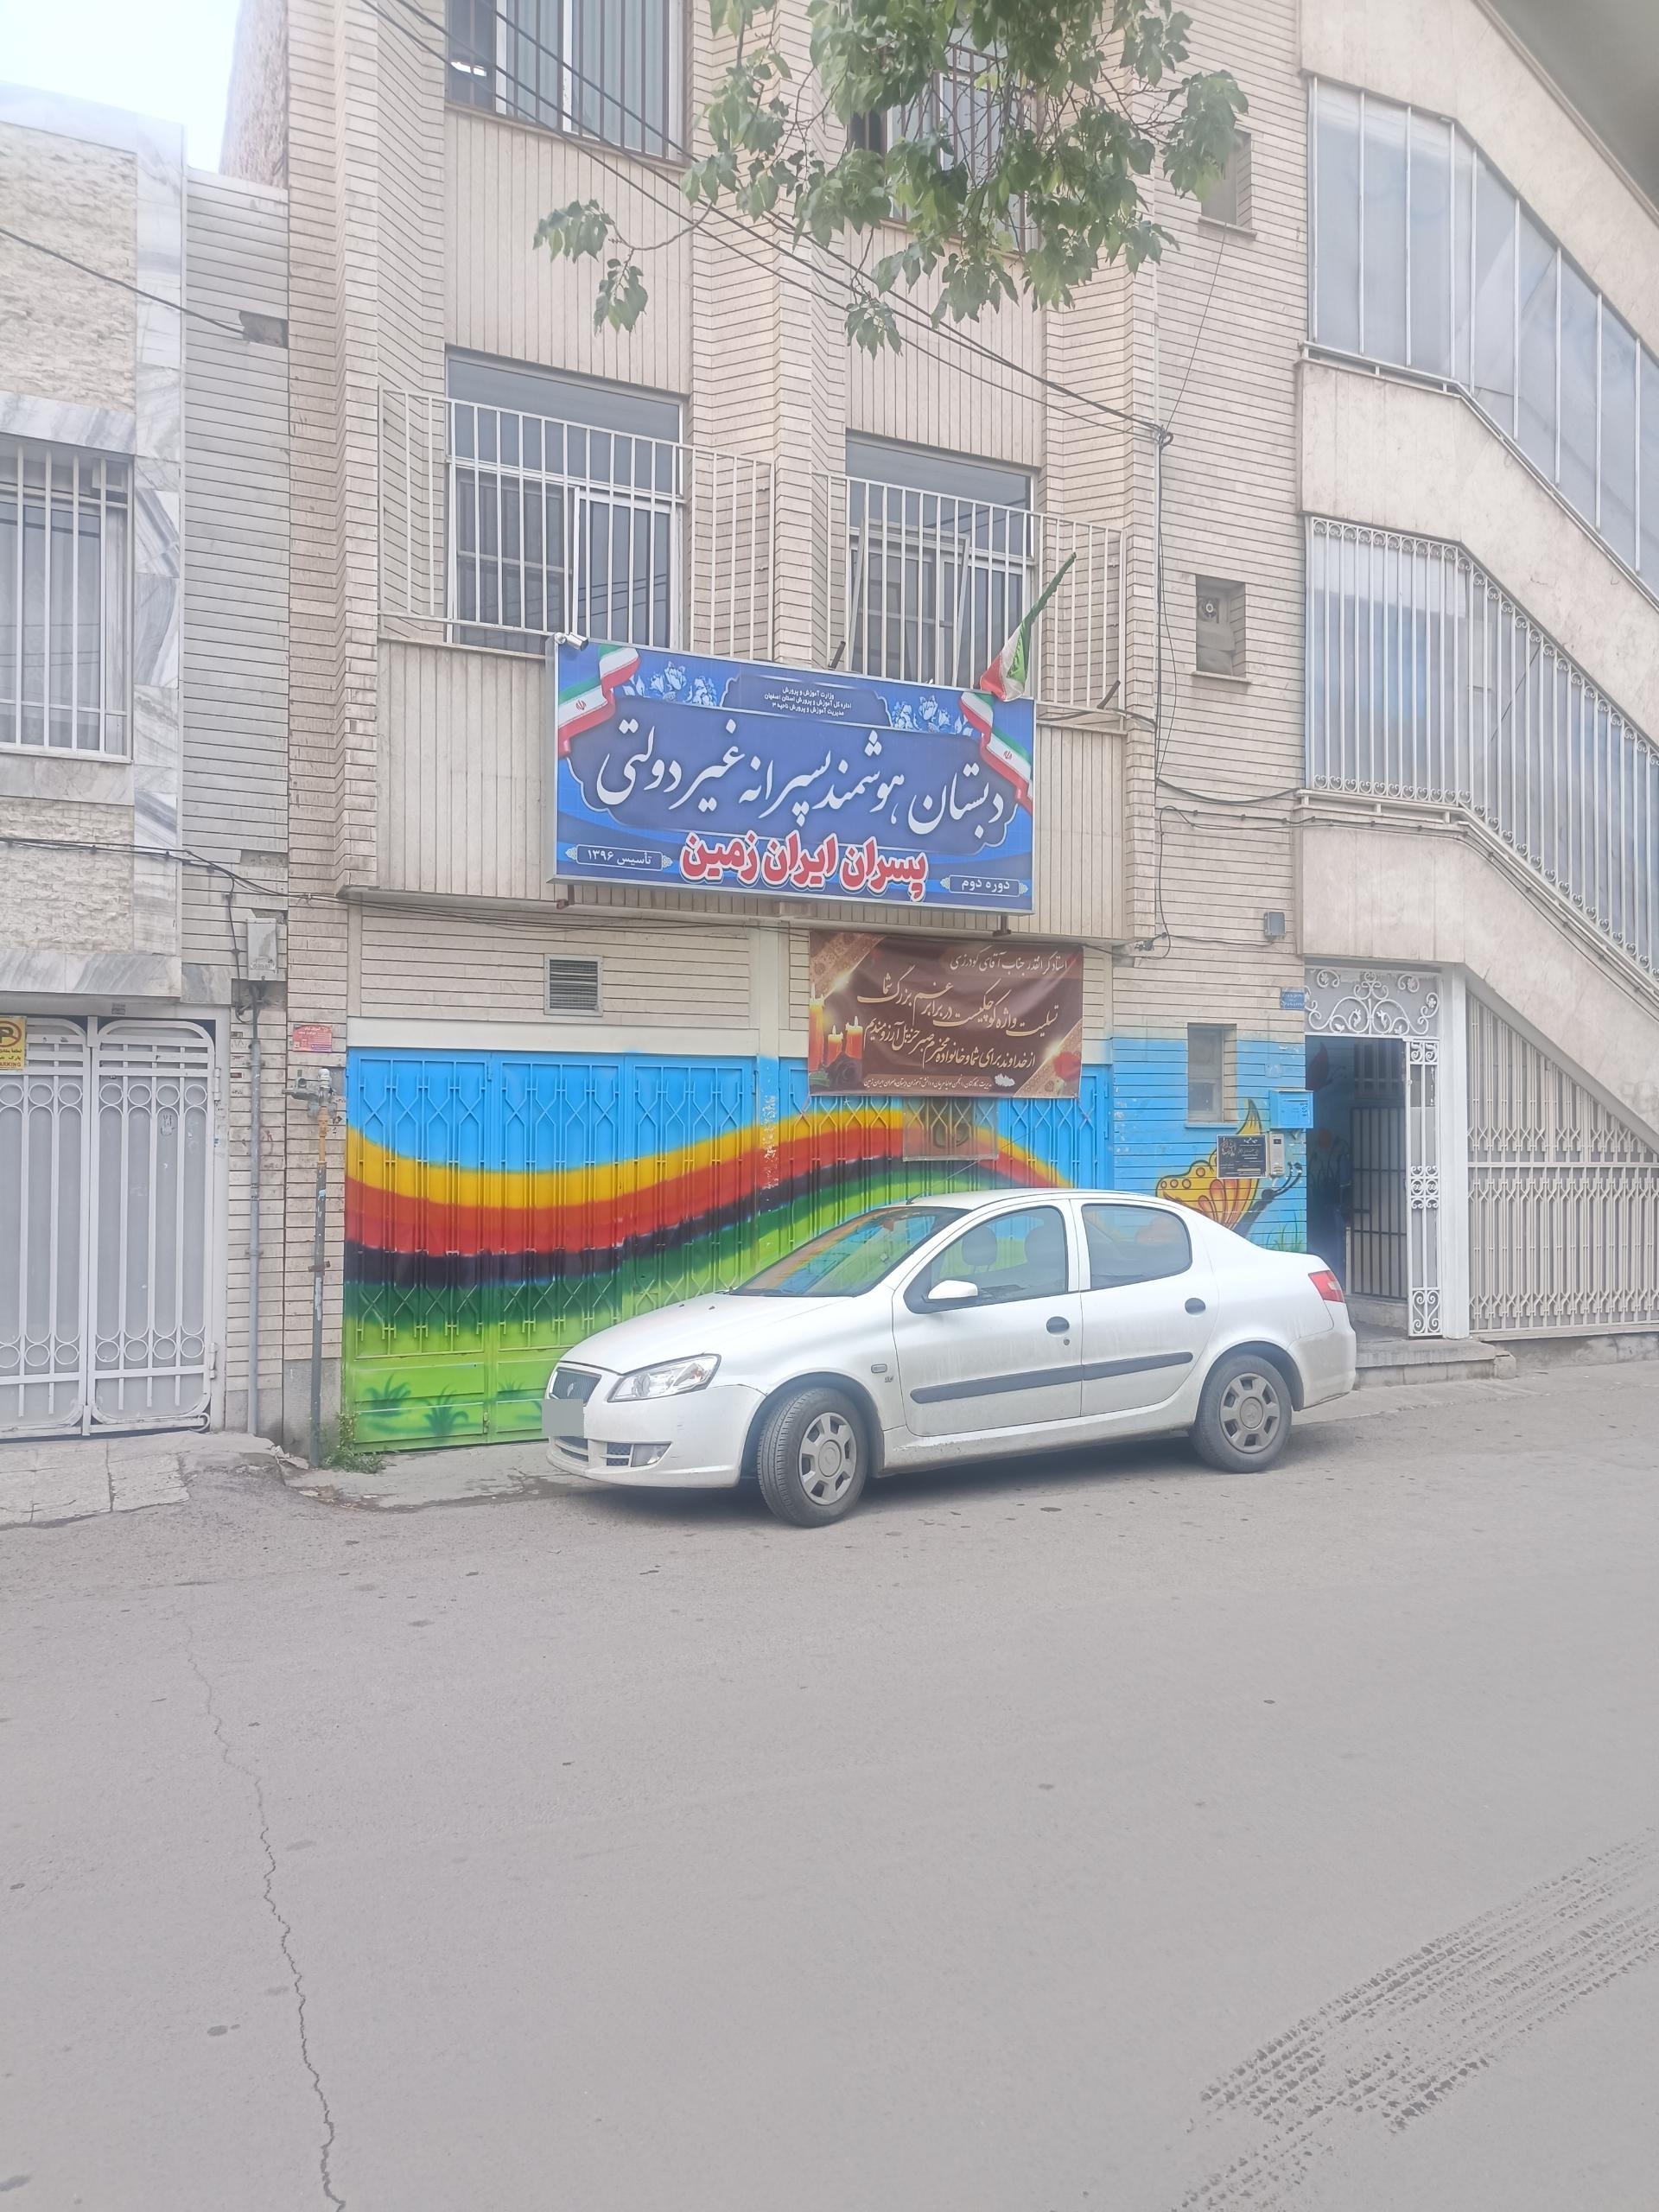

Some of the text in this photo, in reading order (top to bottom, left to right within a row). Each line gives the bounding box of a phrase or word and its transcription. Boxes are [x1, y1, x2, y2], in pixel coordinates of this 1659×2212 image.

[782, 686, 799, 696] پرورش
[795, 696, 813, 706] پرورش
[821, 691, 835, 700] وزارت
[777, 702, 789, 710] ناحیه
[789, 704, 806, 714] پرورش
[810, 706, 827, 715] آموزش
[816, 698, 833, 707] آموزش
[827, 709, 844, 717] مدیریت
[812, 730, 905, 824] هوشمند
[738, 749, 831, 827] پسرانه
[907, 762, 1004, 839] دبستان
[588, 849, 614, 862] ۱۳۹۶
[680, 830, 929, 903] پسران ایران زمین
[961, 879, 1010, 893] دوره دوم
[978, 950, 1008, 971] آقای
[1001, 957, 1025, 976] جناب
[881, 972, 893, 995] شما
[912, 982, 954, 1027] غم
[995, 1007, 1018, 1029] واژه
[1005, 1004, 1059, 1037] تسلیت
[922, 1037, 950, 1070] محترم
[936, 1041, 964, 1064] خانواده
[969, 1046, 980, 1066] شما
[979, 1047, 1002, 1068] برای
[998, 1052, 1027, 1069] خداوند
